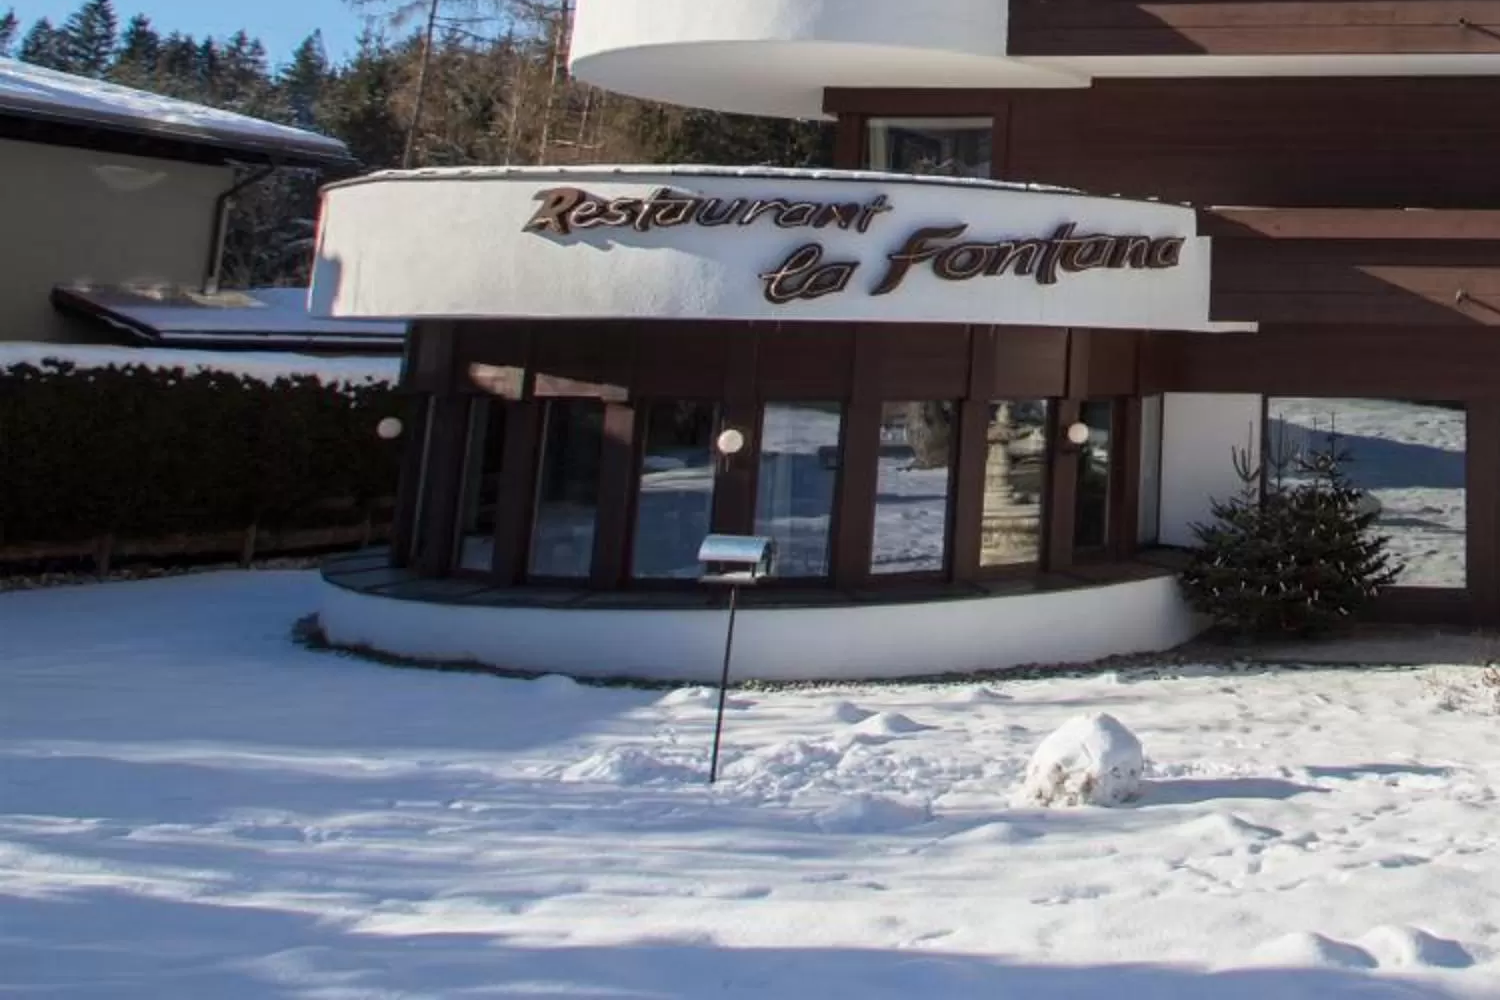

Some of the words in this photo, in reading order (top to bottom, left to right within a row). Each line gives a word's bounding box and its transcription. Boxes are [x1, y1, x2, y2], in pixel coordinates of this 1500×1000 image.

[521, 186, 893, 234] Restaurant
[758, 242, 861, 304] la
[868, 222, 1187, 296] Fontana
